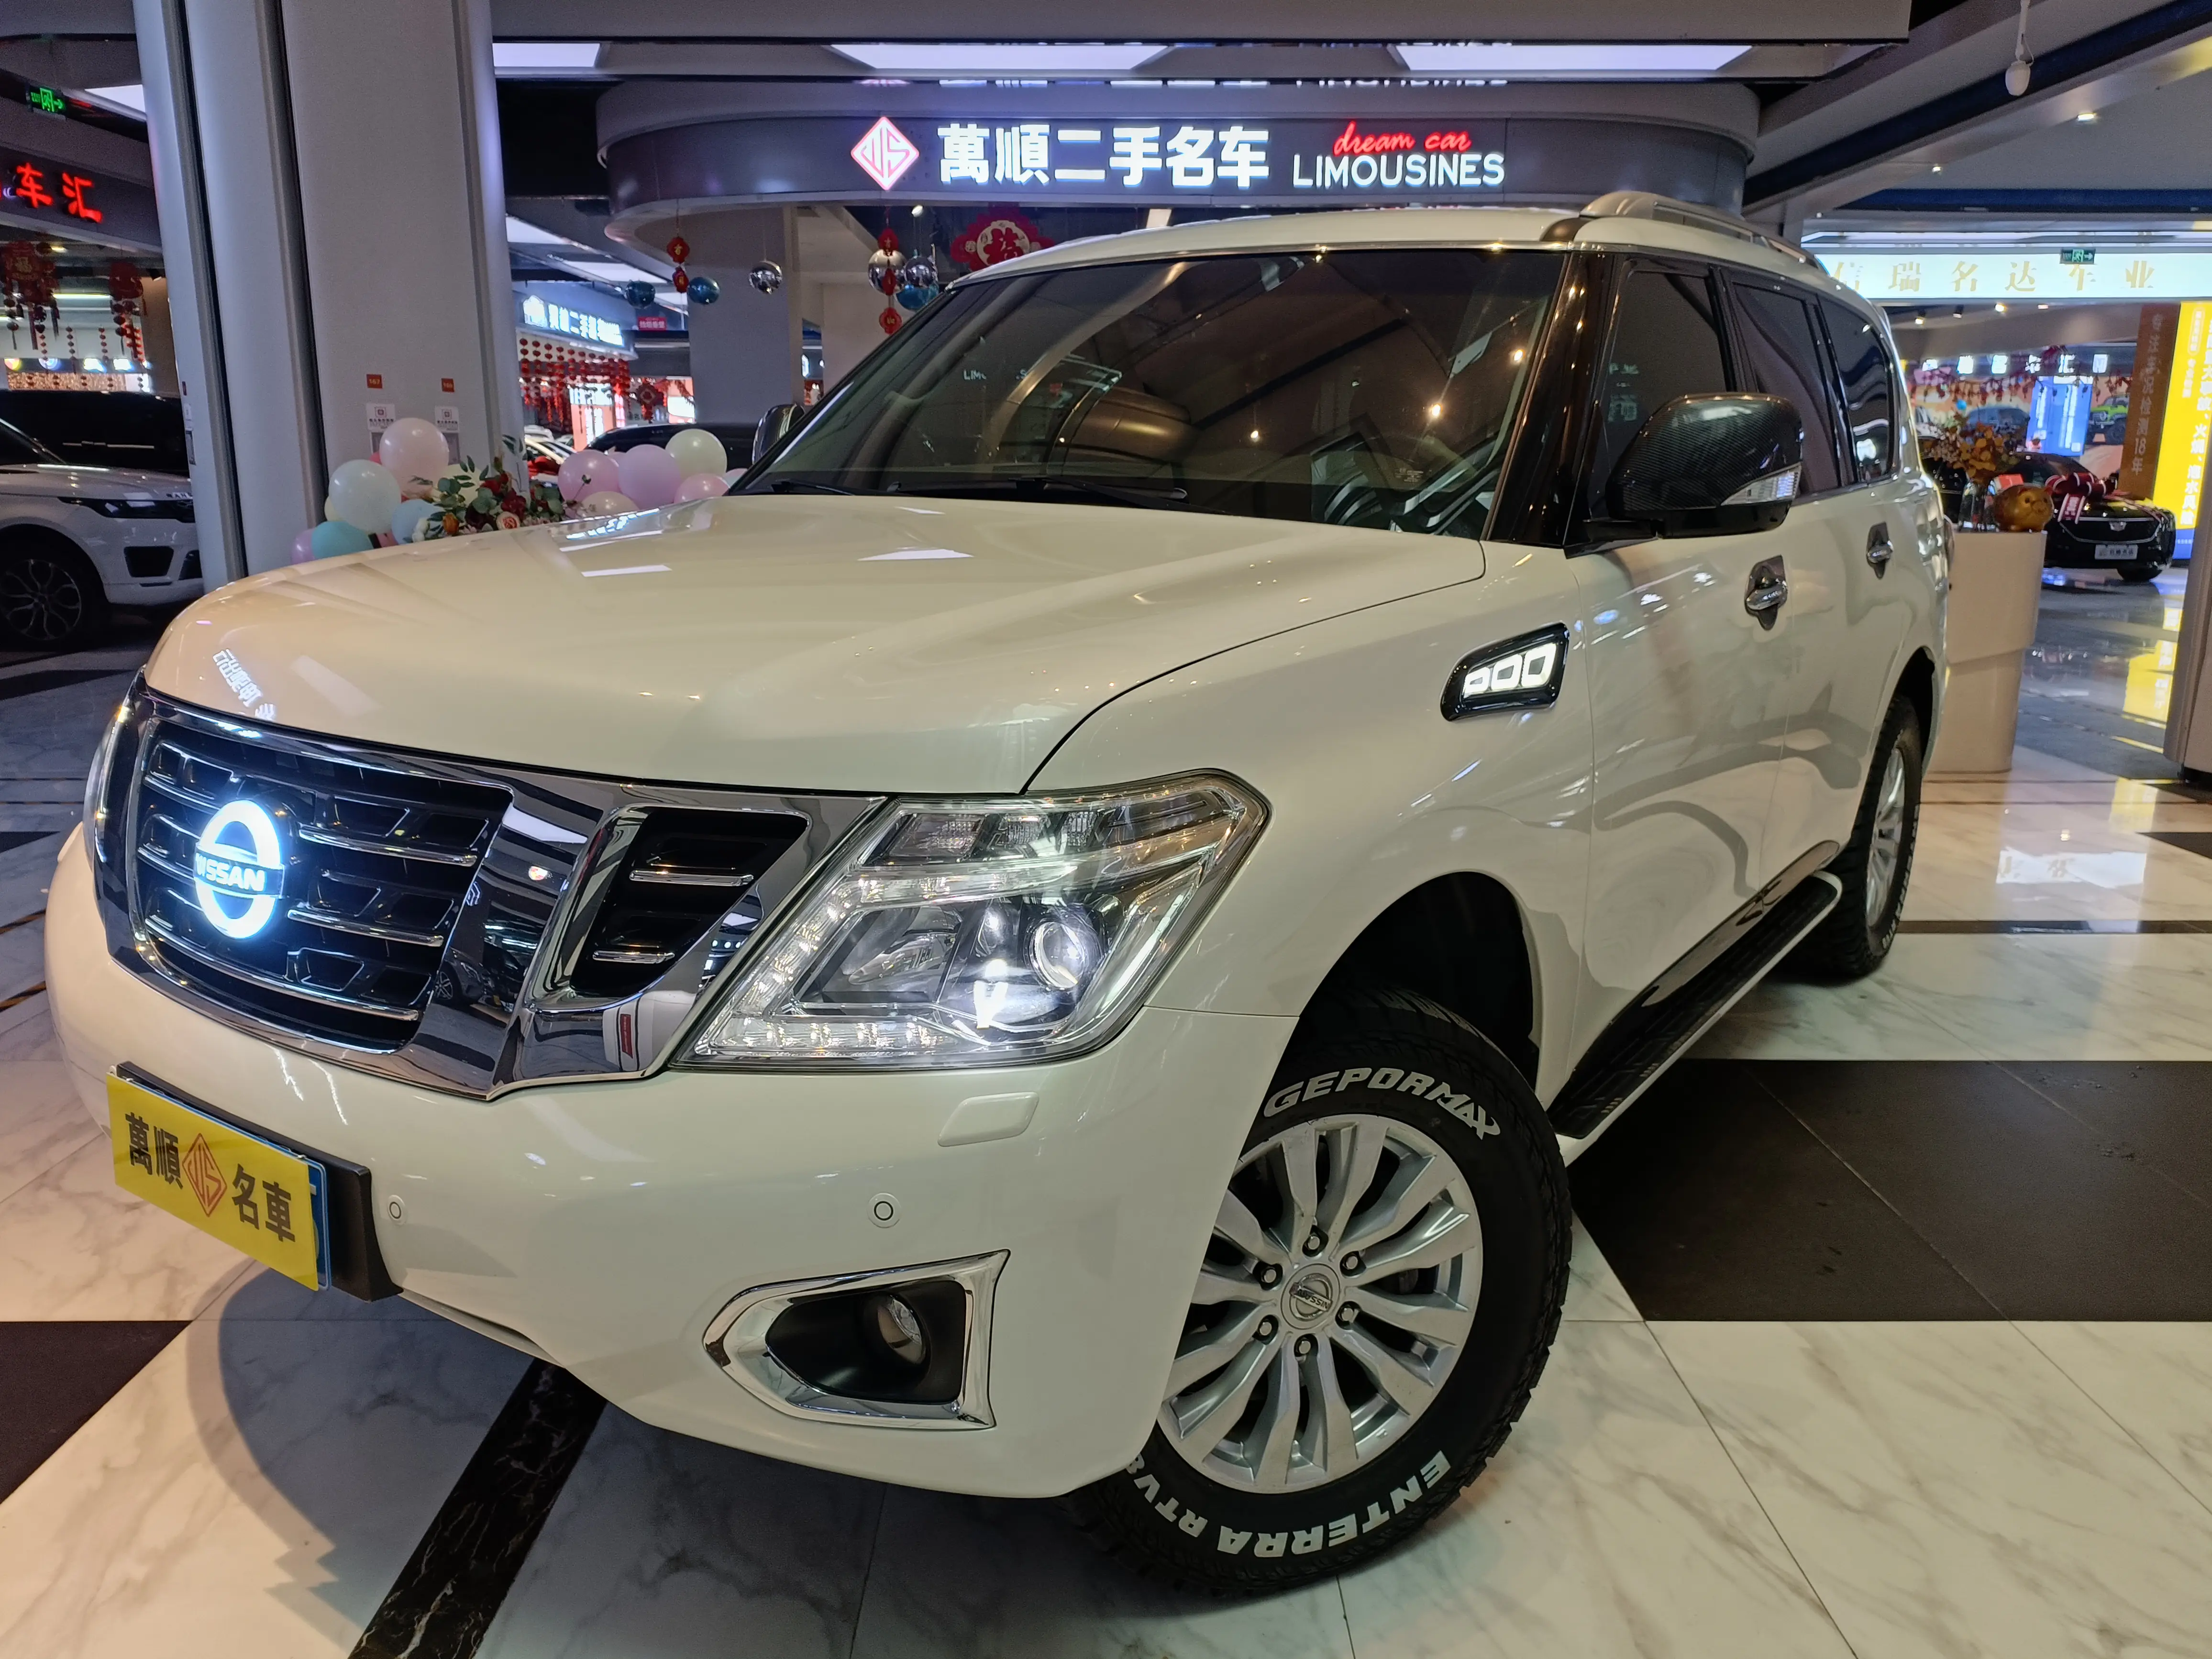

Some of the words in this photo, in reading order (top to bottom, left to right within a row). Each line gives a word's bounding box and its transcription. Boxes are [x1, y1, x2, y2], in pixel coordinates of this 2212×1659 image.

[937, 122, 1270, 189] 萬順二手名车
[1334, 121, 1415, 156] dream
[1424, 130, 1472, 151] car
[0, 163, 103, 224] 车汇
[1293, 153, 1505, 189] LIMOUSINES
[195, 852, 266, 892] NISSAN
[1263, 1067, 1501, 1140] GEPORMAX
[125, 1112, 183, 1190] 萬順
[232, 1163, 296, 1243] 名車
[1217, 1450, 1452, 1558] ENTERRA
